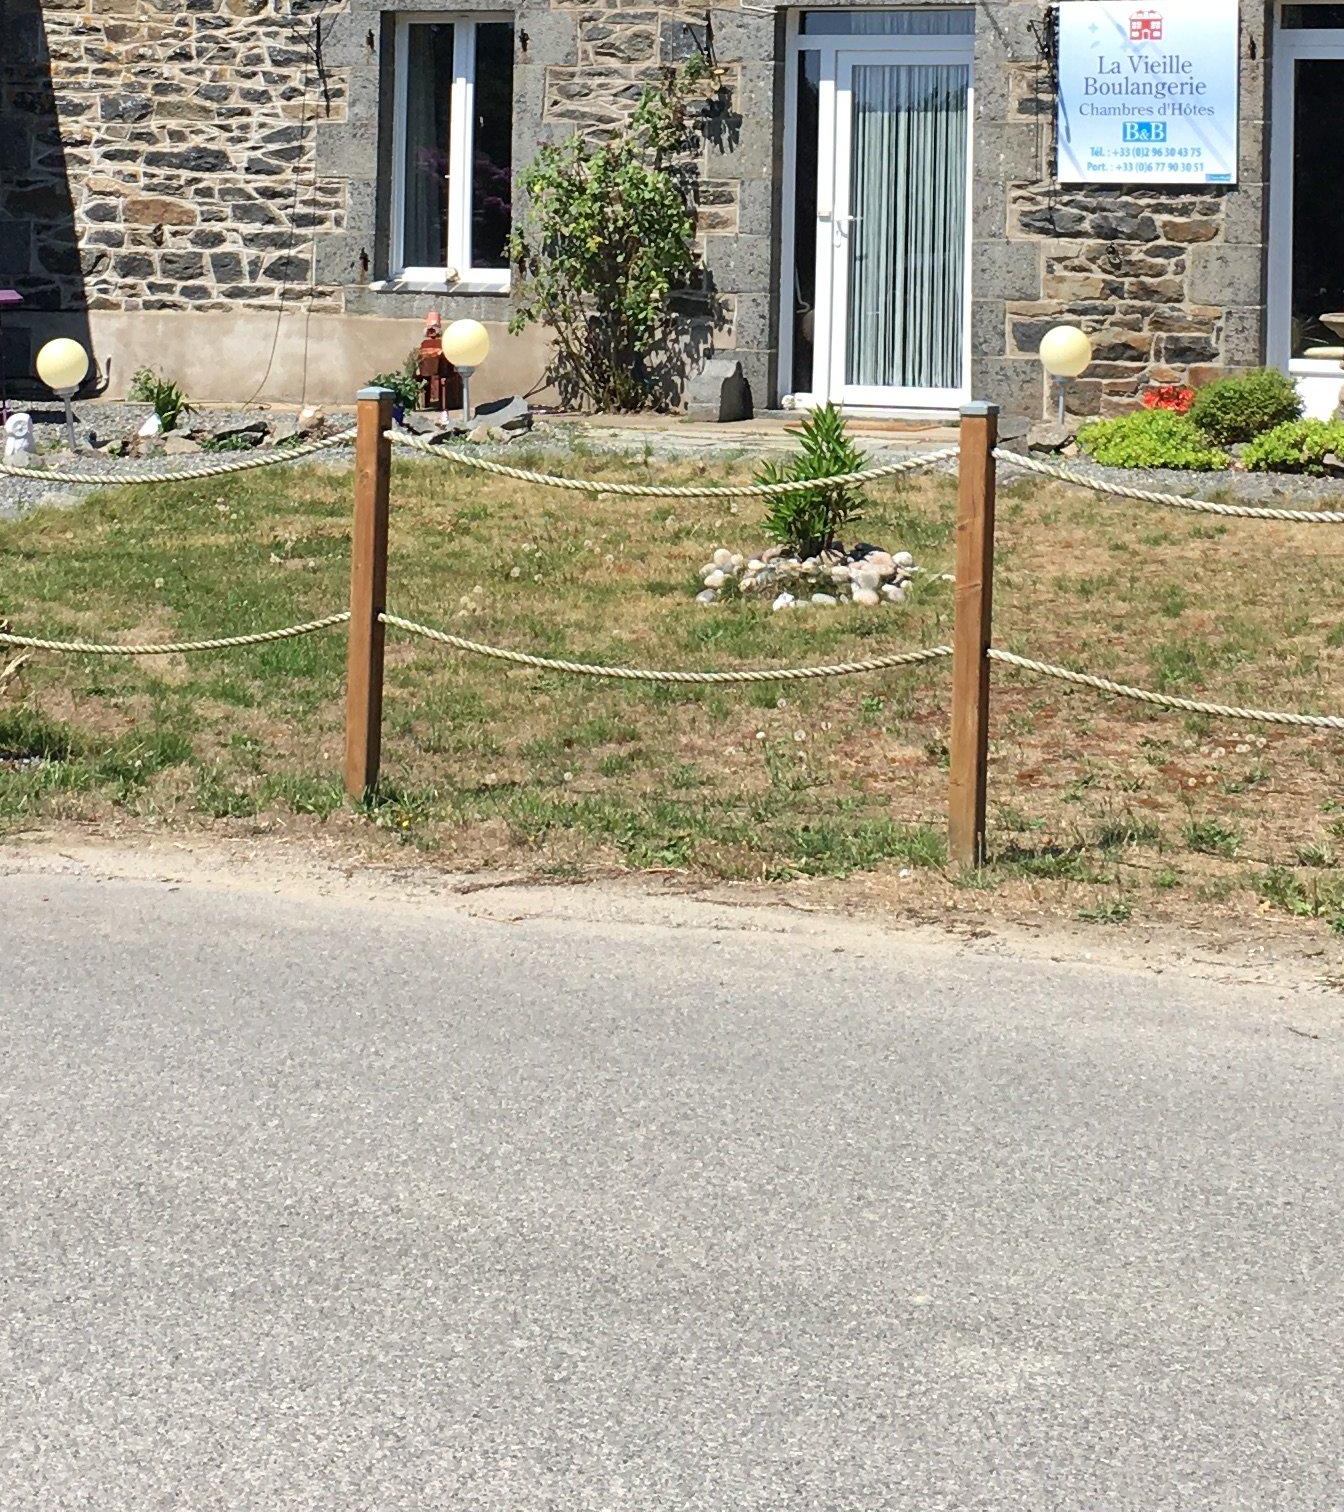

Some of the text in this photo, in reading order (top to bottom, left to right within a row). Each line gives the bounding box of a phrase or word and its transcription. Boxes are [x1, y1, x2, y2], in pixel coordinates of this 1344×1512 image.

[1098, 55, 1193, 75] La Vieille
[1084, 76, 1207, 99] Boulangerie
[1079, 102, 1215, 116] Chambres d'Hôtes
[1125, 122, 1165, 140] B&B
[1112, 147, 1130, 157] +33
[1177, 147, 1189, 157] 43
[1190, 147, 1202, 157] 75
[1115, 162, 1133, 172] +33
[1155, 162, 1166, 172] 77
[1167, 162, 1179, 172] 90
[1193, 162, 1204, 172] 51
